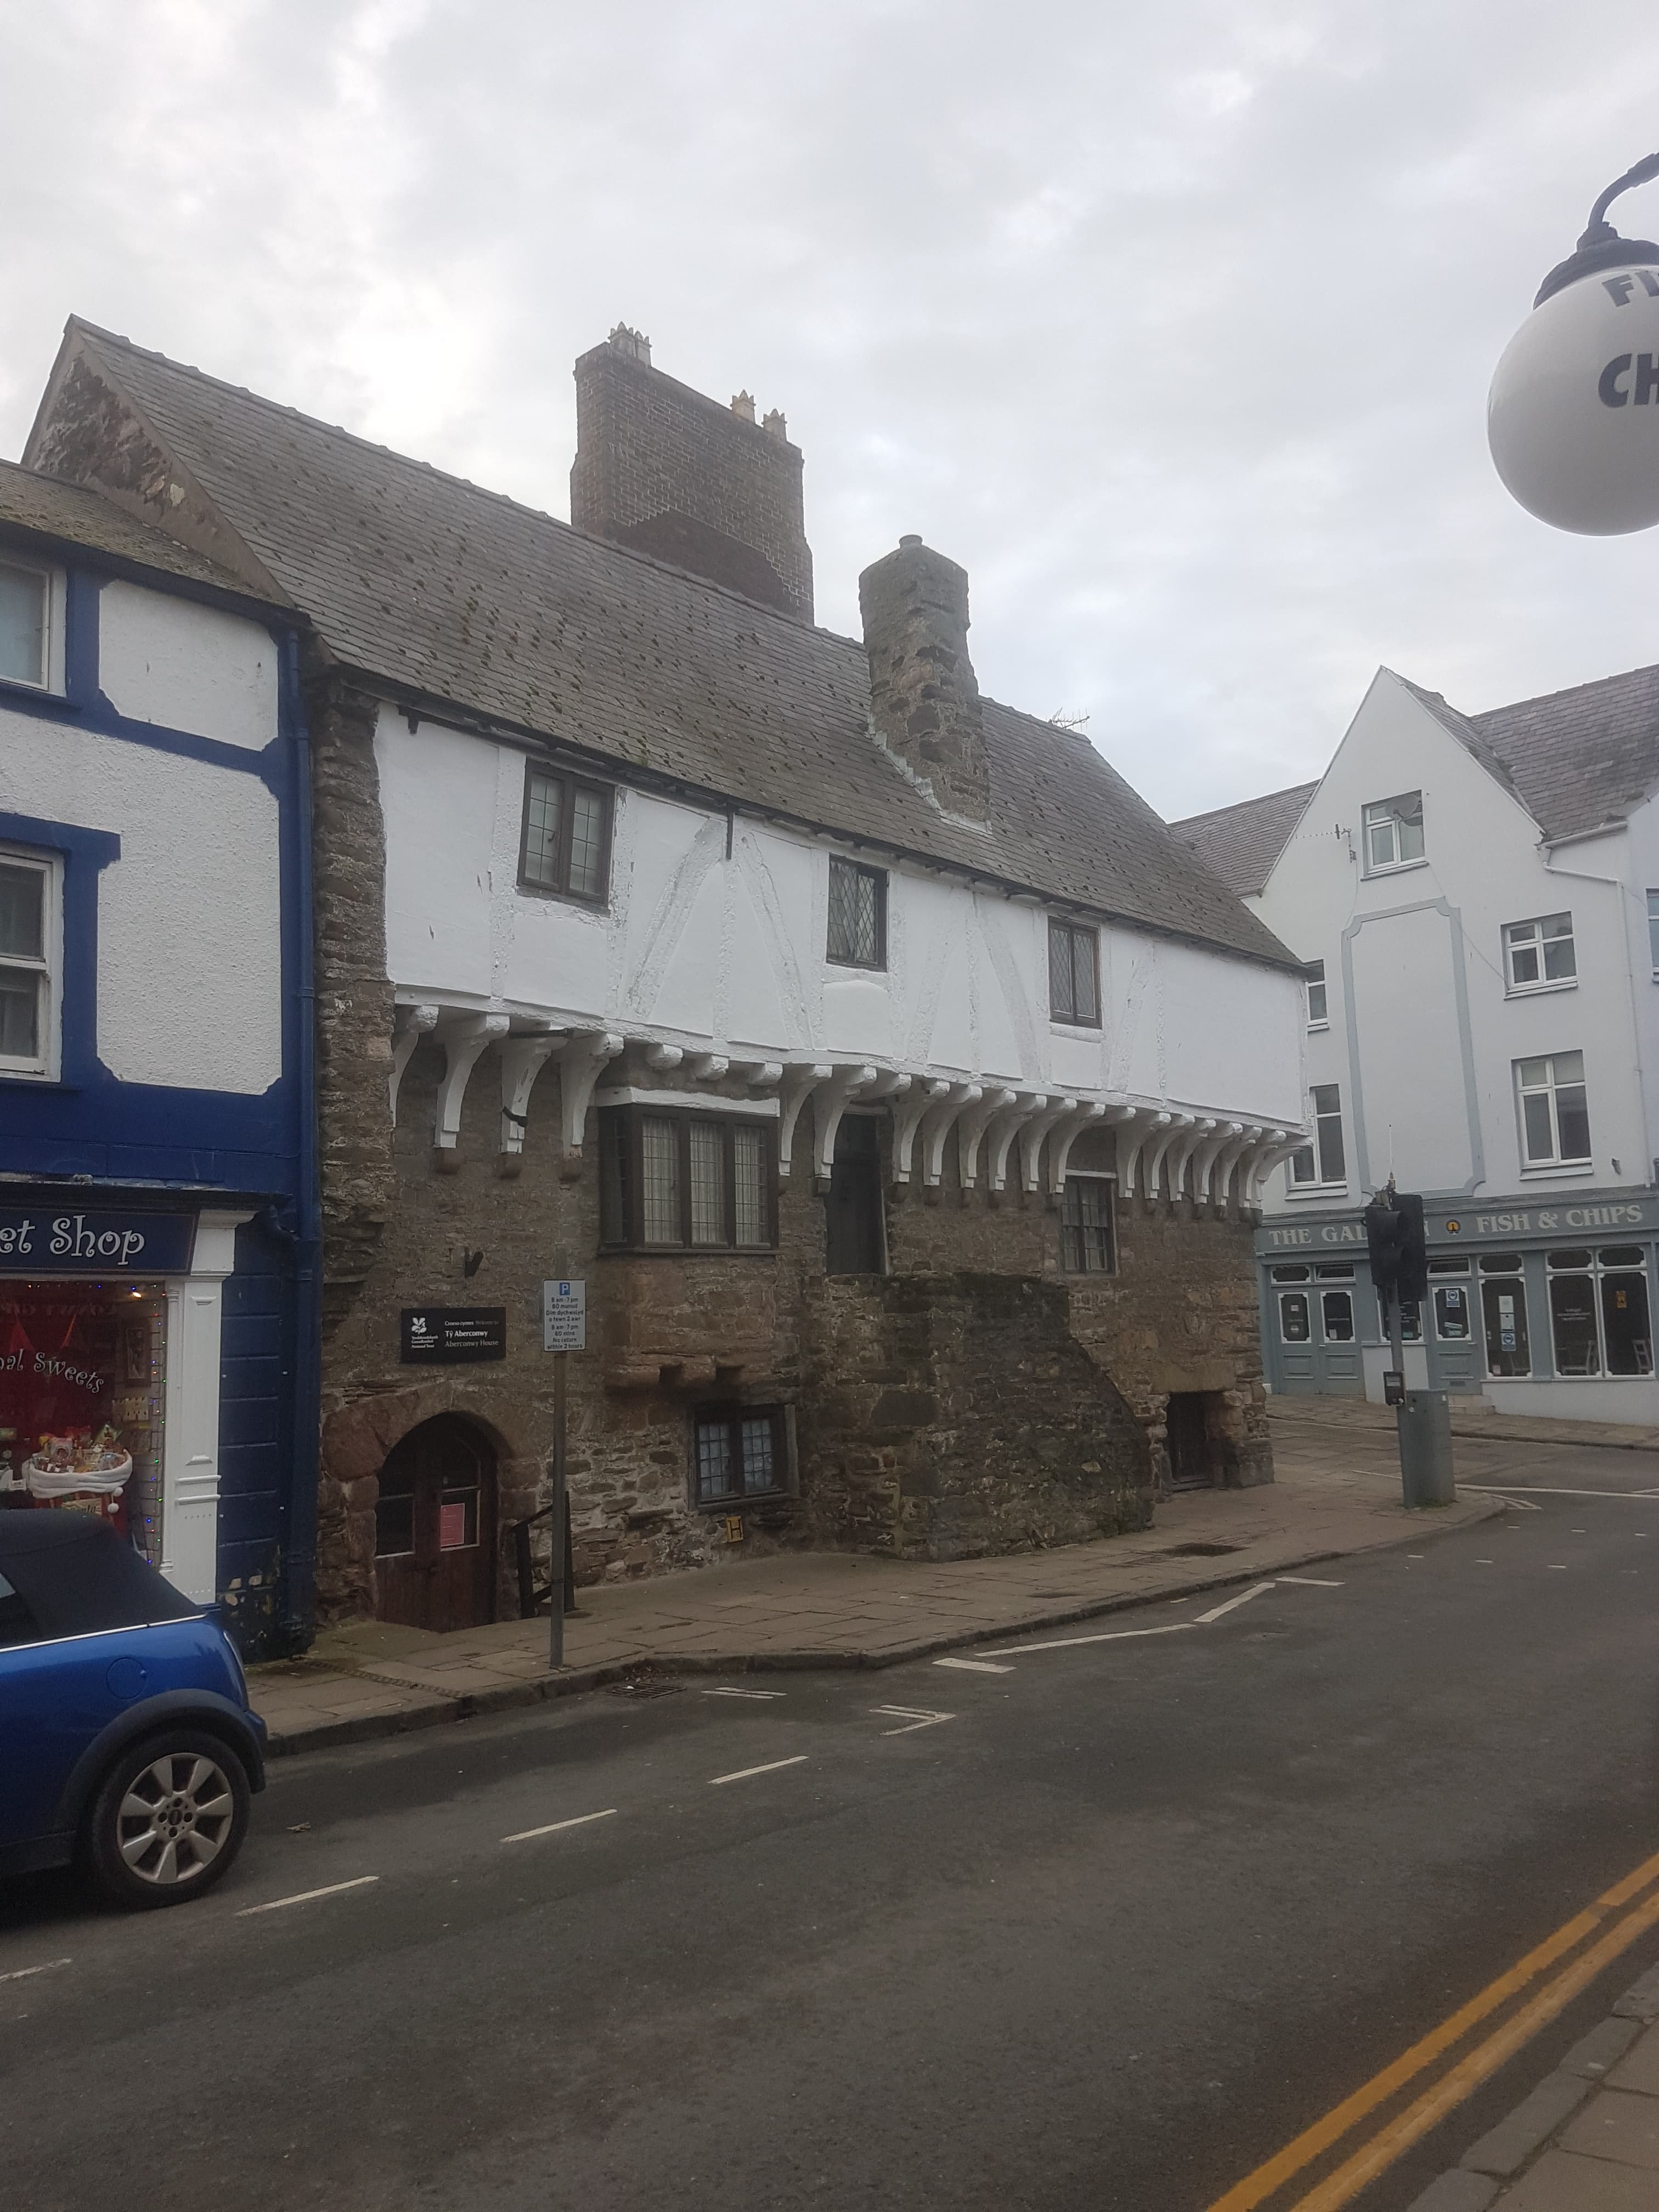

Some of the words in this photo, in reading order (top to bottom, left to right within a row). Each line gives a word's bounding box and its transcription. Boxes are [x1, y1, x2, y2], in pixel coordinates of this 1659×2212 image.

[1601, 271, 1659, 308] FI
[1475, 1214, 1531, 1234] FISH
[1538, 1211, 1559, 1229] &
[1565, 1204, 1644, 1228] CHIPS
[49, 1214, 145, 1266] Shop
[1268, 1228, 1312, 1246] THE
[562, 1284, 569, 1294] P
[33, 1352, 104, 1393] Sweets
[727, 1519, 742, 1540] H
